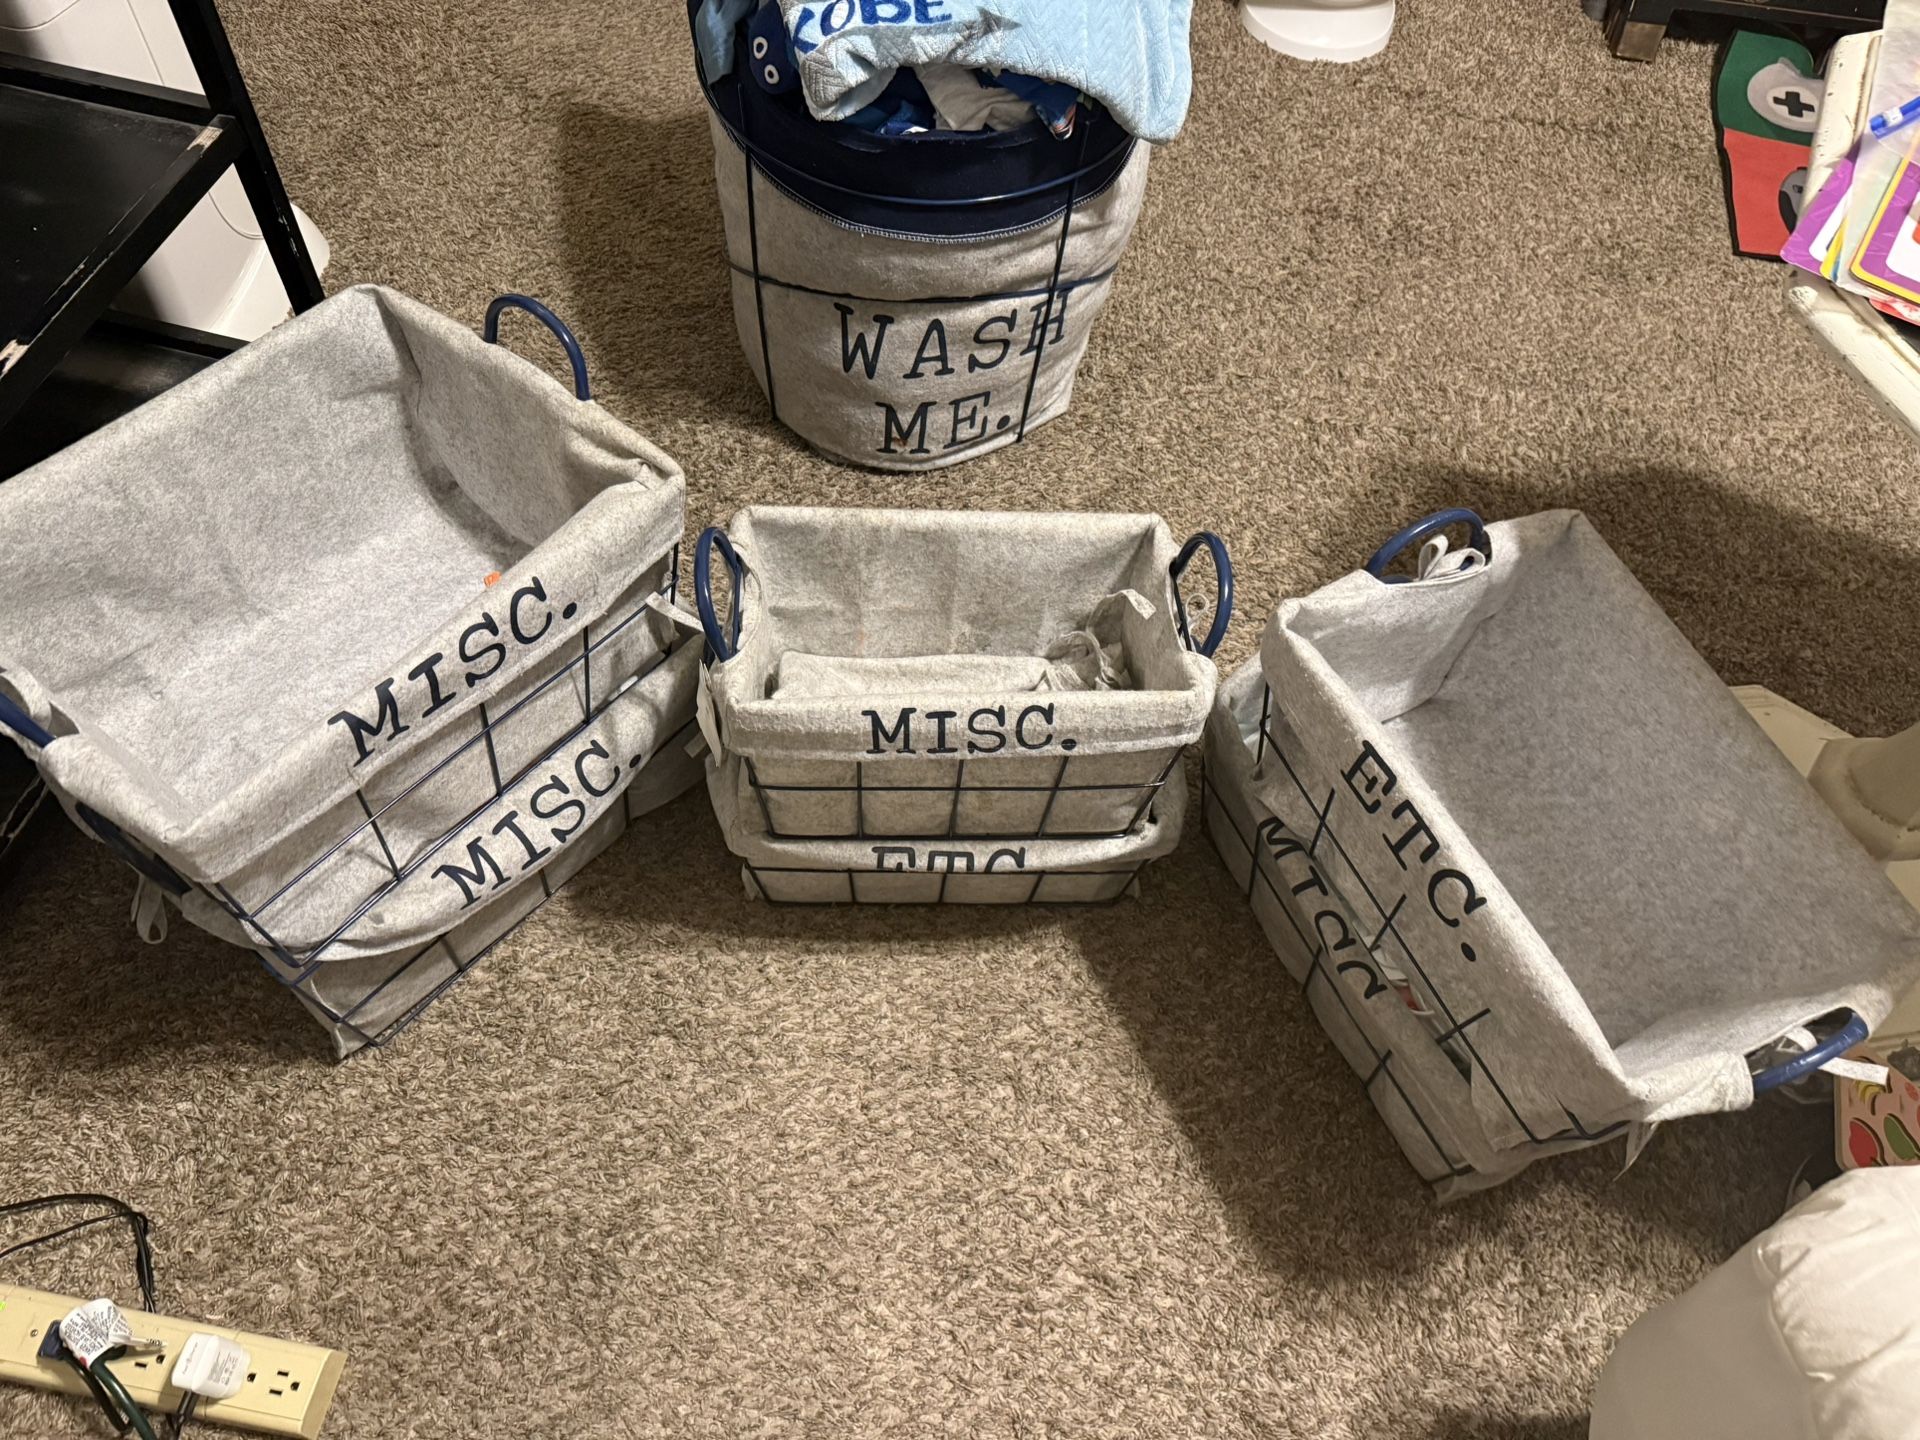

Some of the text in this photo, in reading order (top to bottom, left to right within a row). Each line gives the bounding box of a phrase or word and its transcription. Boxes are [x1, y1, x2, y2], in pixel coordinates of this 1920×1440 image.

[834, 289, 1070, 379] WASH
[876, 391, 1011, 455] ME.
[327, 576, 577, 768] MISC.
[861, 702, 1077, 754] MISC.
[431, 739, 642, 910] MISC.
[1340, 739, 1487, 962] ETC.
